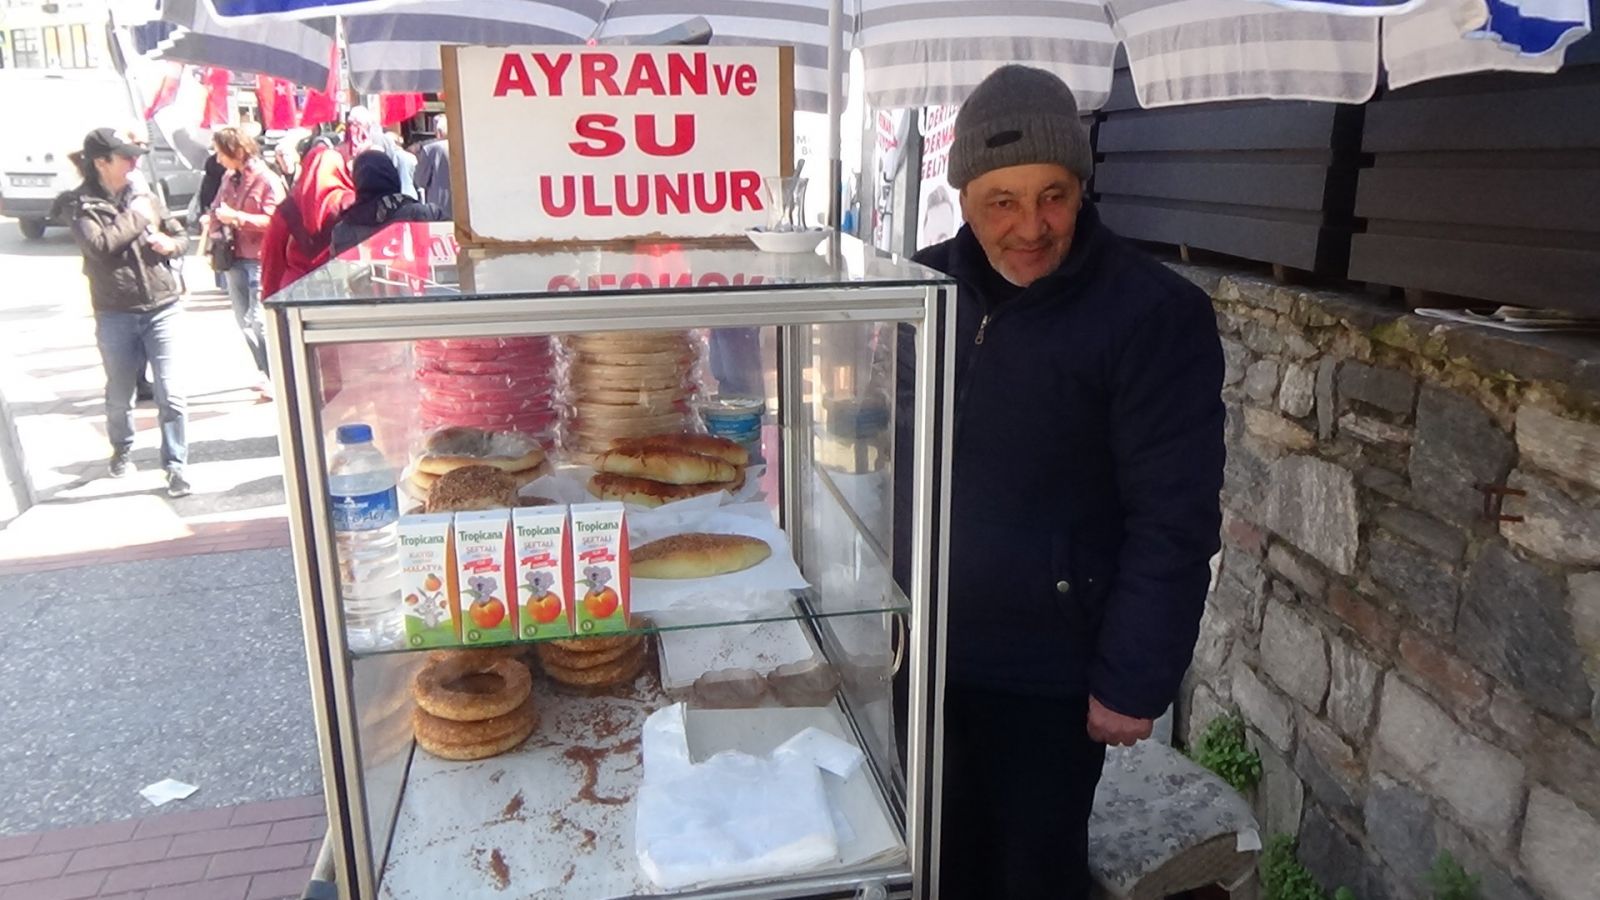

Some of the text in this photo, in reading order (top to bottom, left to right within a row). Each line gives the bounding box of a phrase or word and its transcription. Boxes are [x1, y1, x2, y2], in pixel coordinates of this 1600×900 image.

[493, 52, 757, 97] AYRAN ve
[568, 113, 696, 158] SU
[540, 170, 764, 218] ULUNUR
[517, 525, 560, 538] Tropicana
[576, 521, 619, 533] Tropicana
[399, 534, 444, 546] Tropicana
[459, 530, 503, 543] Tropicana
